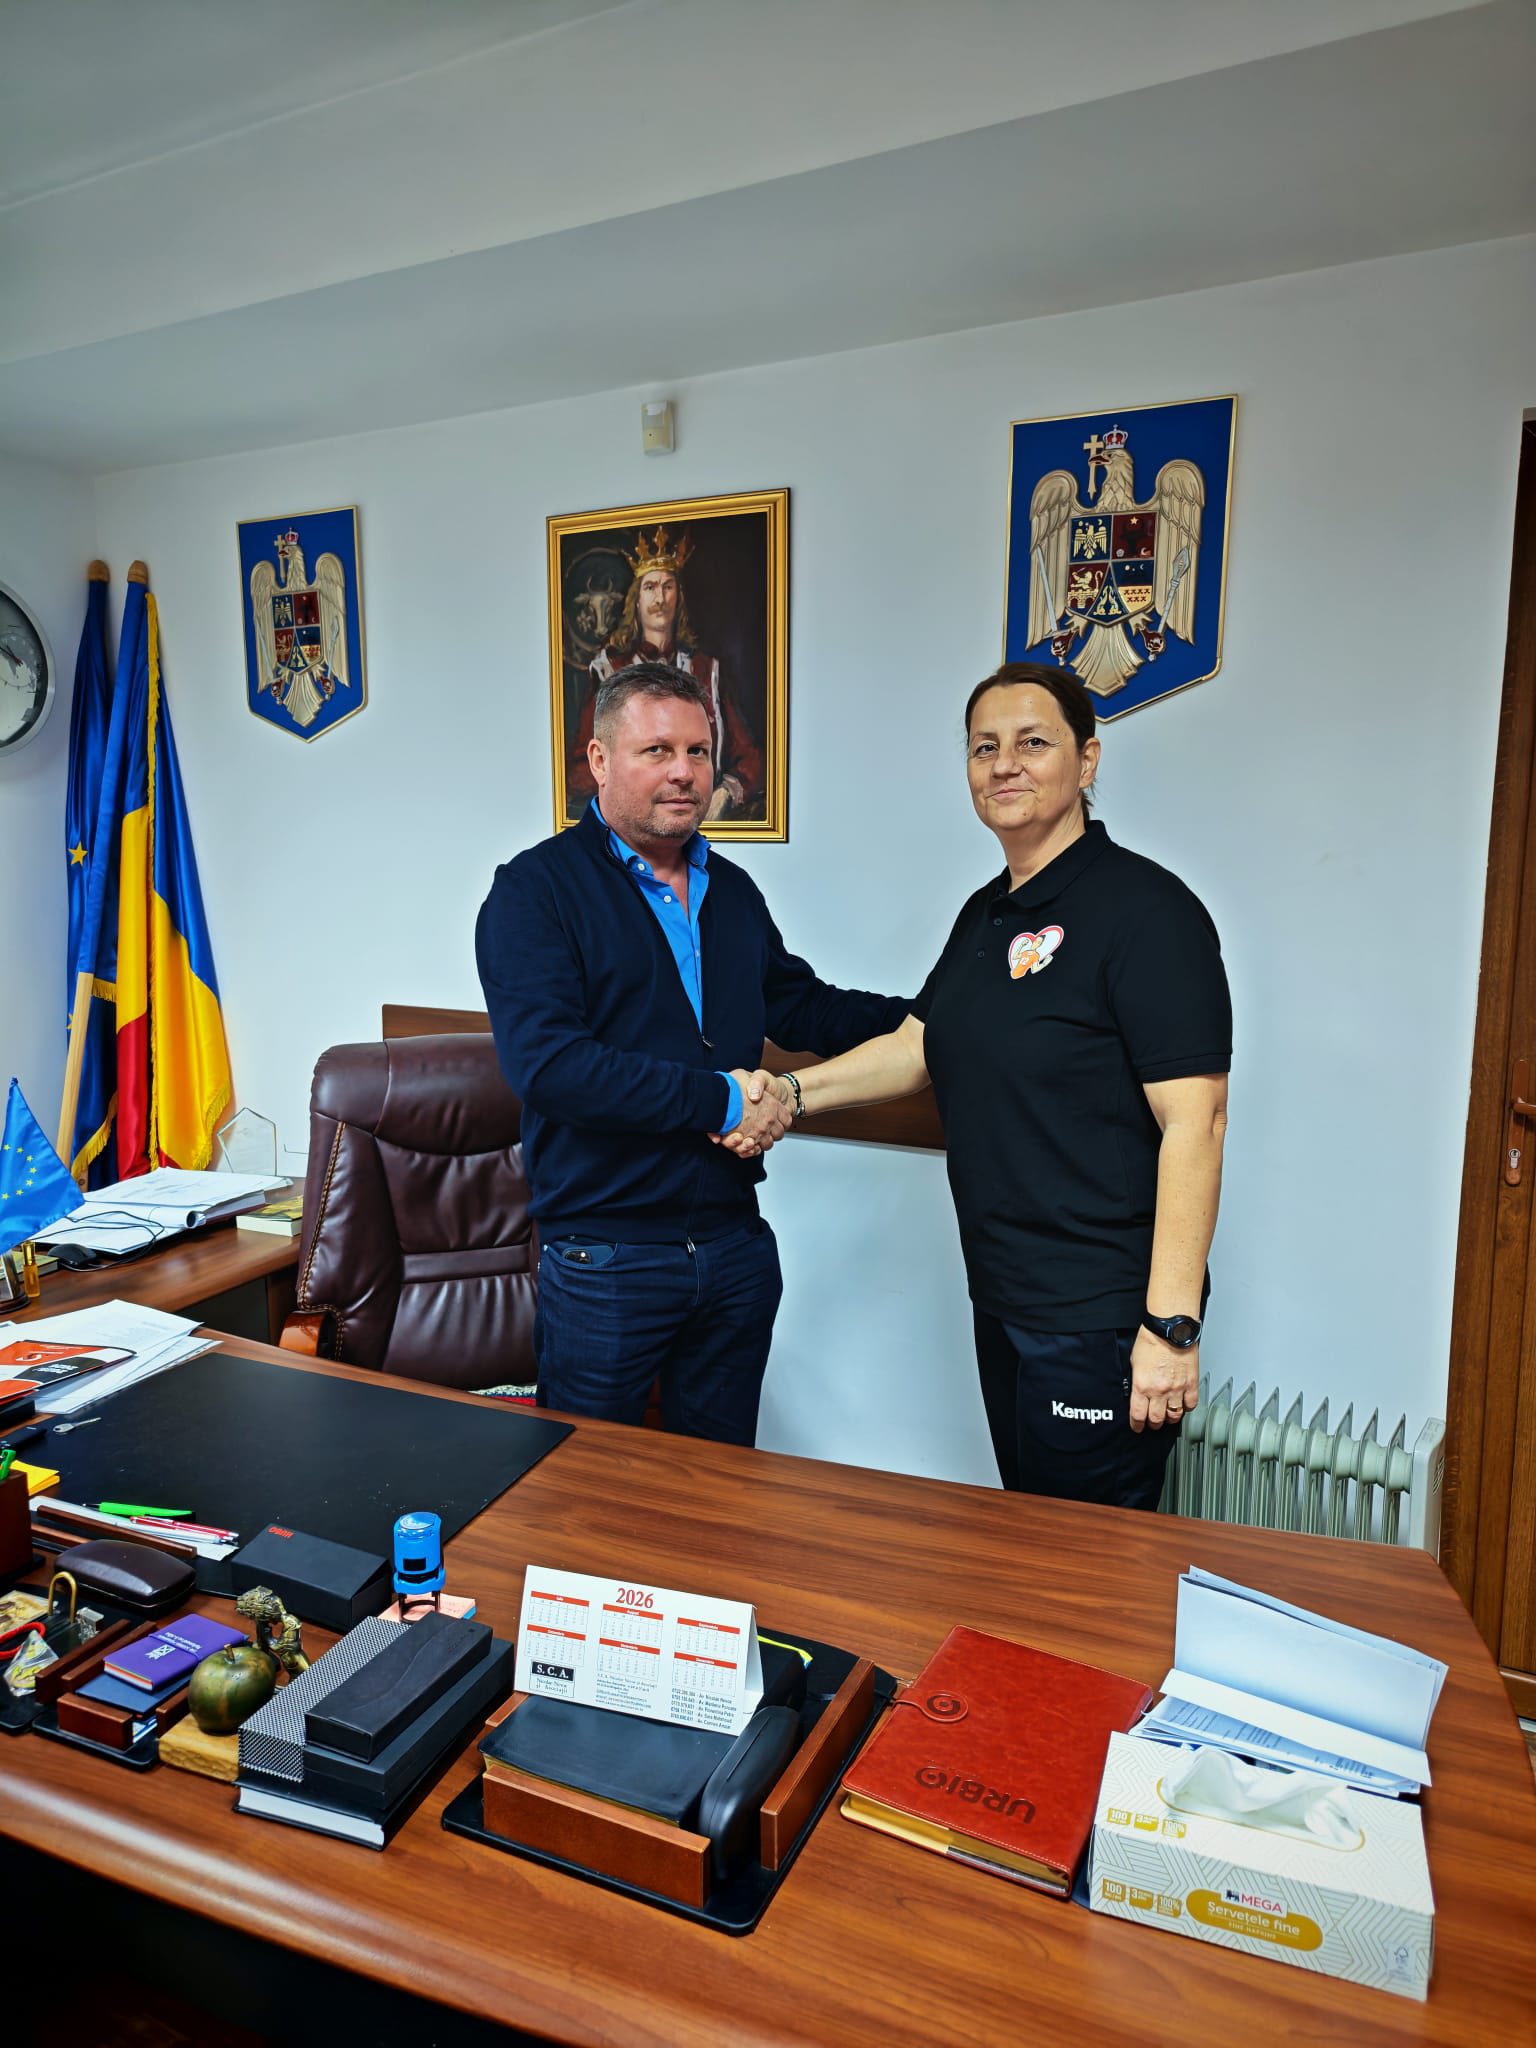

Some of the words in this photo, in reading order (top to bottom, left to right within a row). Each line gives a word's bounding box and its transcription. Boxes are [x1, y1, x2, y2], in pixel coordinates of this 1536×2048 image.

[1052, 1400, 1113, 1424] Kempa
[616, 1587, 654, 1608] 2026
[914, 1766, 1037, 1824] URBIO
[1104, 1881, 1122, 1895] 100
[1241, 1893, 1283, 1914] MEGA
[1273, 1919, 1300, 1936] fine
